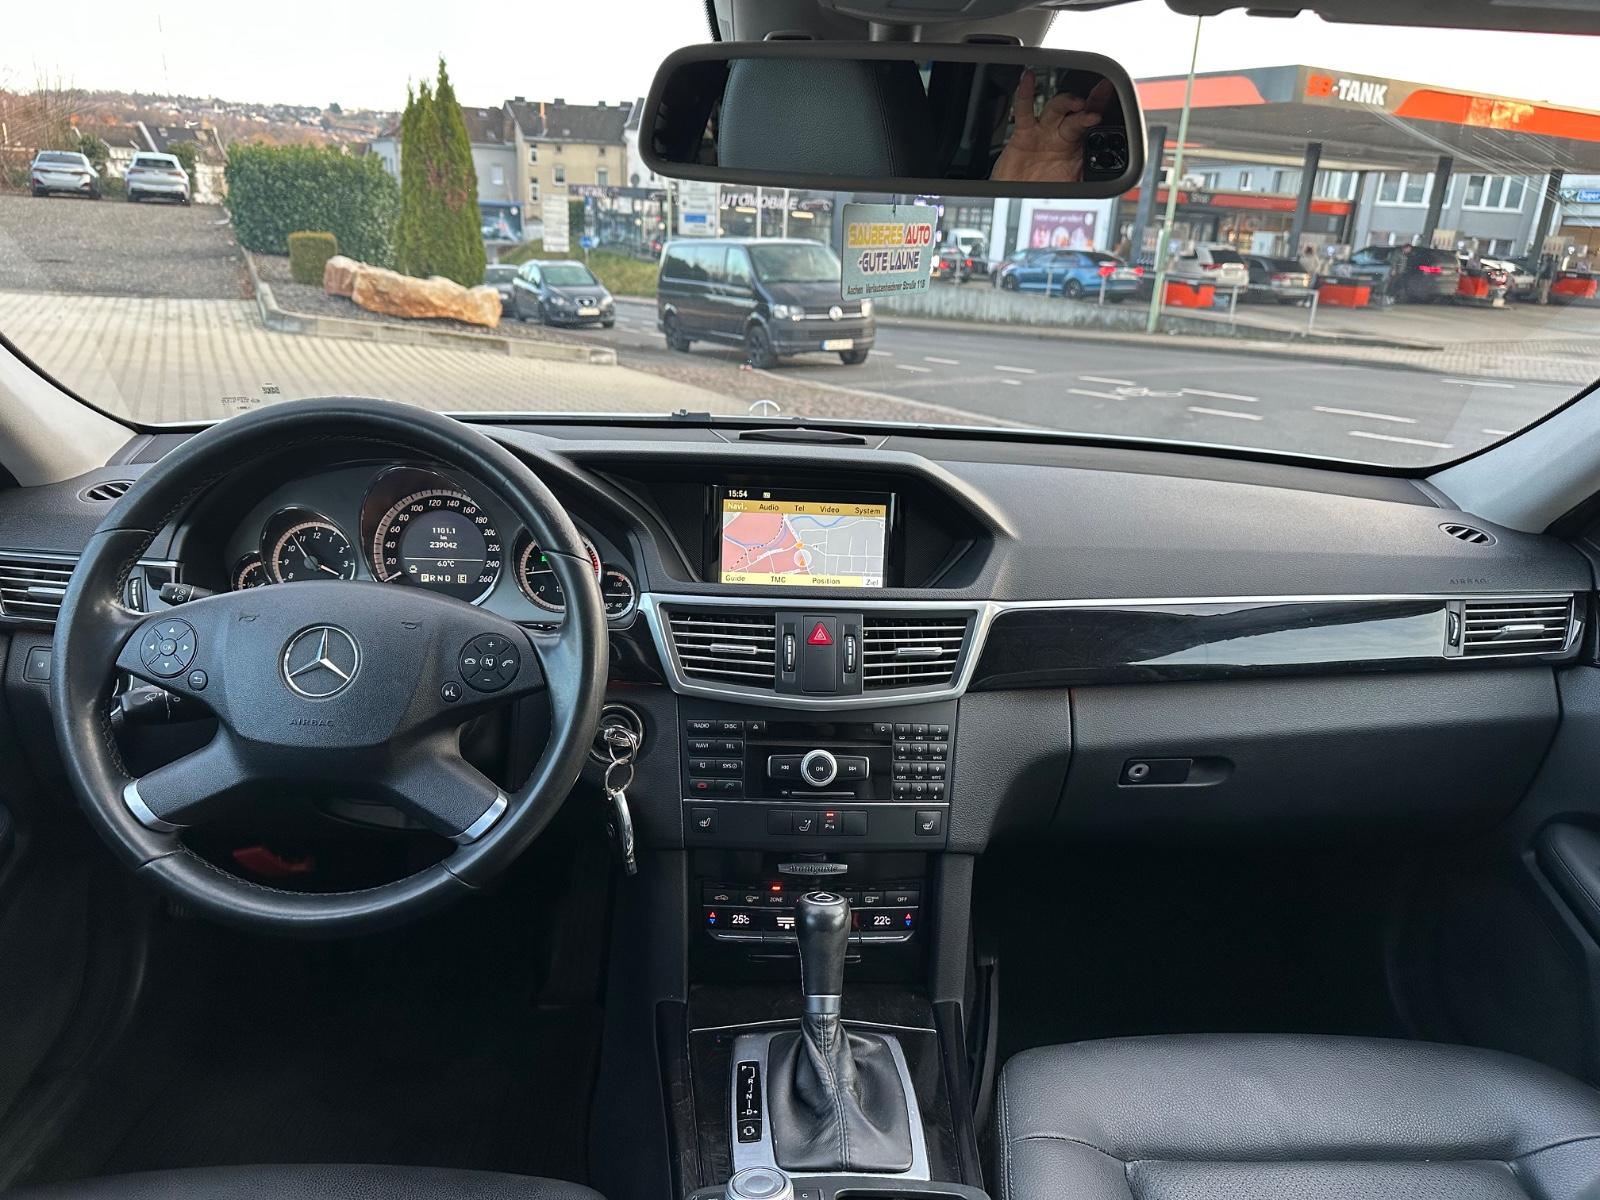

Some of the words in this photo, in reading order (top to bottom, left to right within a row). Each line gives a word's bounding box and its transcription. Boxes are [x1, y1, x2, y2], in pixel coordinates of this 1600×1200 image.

[721, 193, 800, 210] UTOMOBILE
[849, 223, 903, 246] SAUBERES
[905, 225, 931, 245] AUTO
[890, 251, 920, 271] LAUNE
[728, 490, 748, 498] 15:54
[463, 506, 476, 514] 160
[727, 502, 744, 510] Navi
[759, 503, 779, 511] Audio
[855, 507, 881, 515] System
[429, 541, 457, 549] 239042
[725, 574, 746, 582] Guide
[812, 577, 841, 585] Position
[865, 578, 878, 586] Ziel
